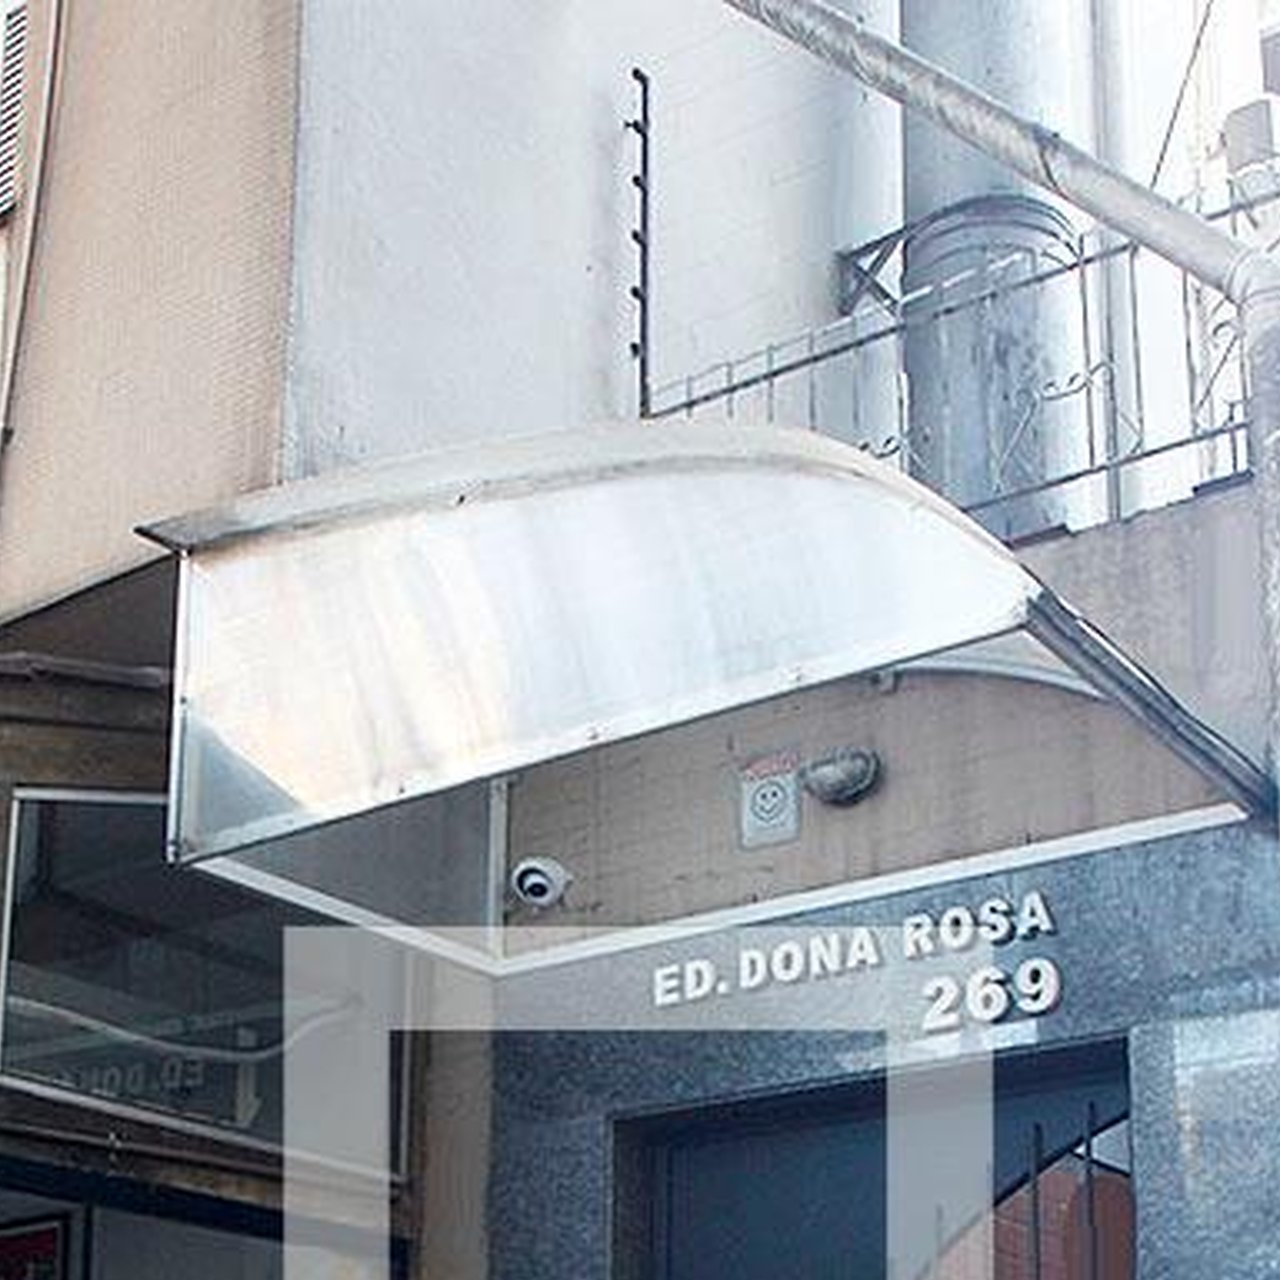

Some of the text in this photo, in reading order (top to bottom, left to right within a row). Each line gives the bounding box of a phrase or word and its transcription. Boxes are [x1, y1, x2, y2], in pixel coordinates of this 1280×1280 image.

[653, 891, 1055, 1006] ED. DONA ROSA
[923, 957, 1061, 1032] 269
